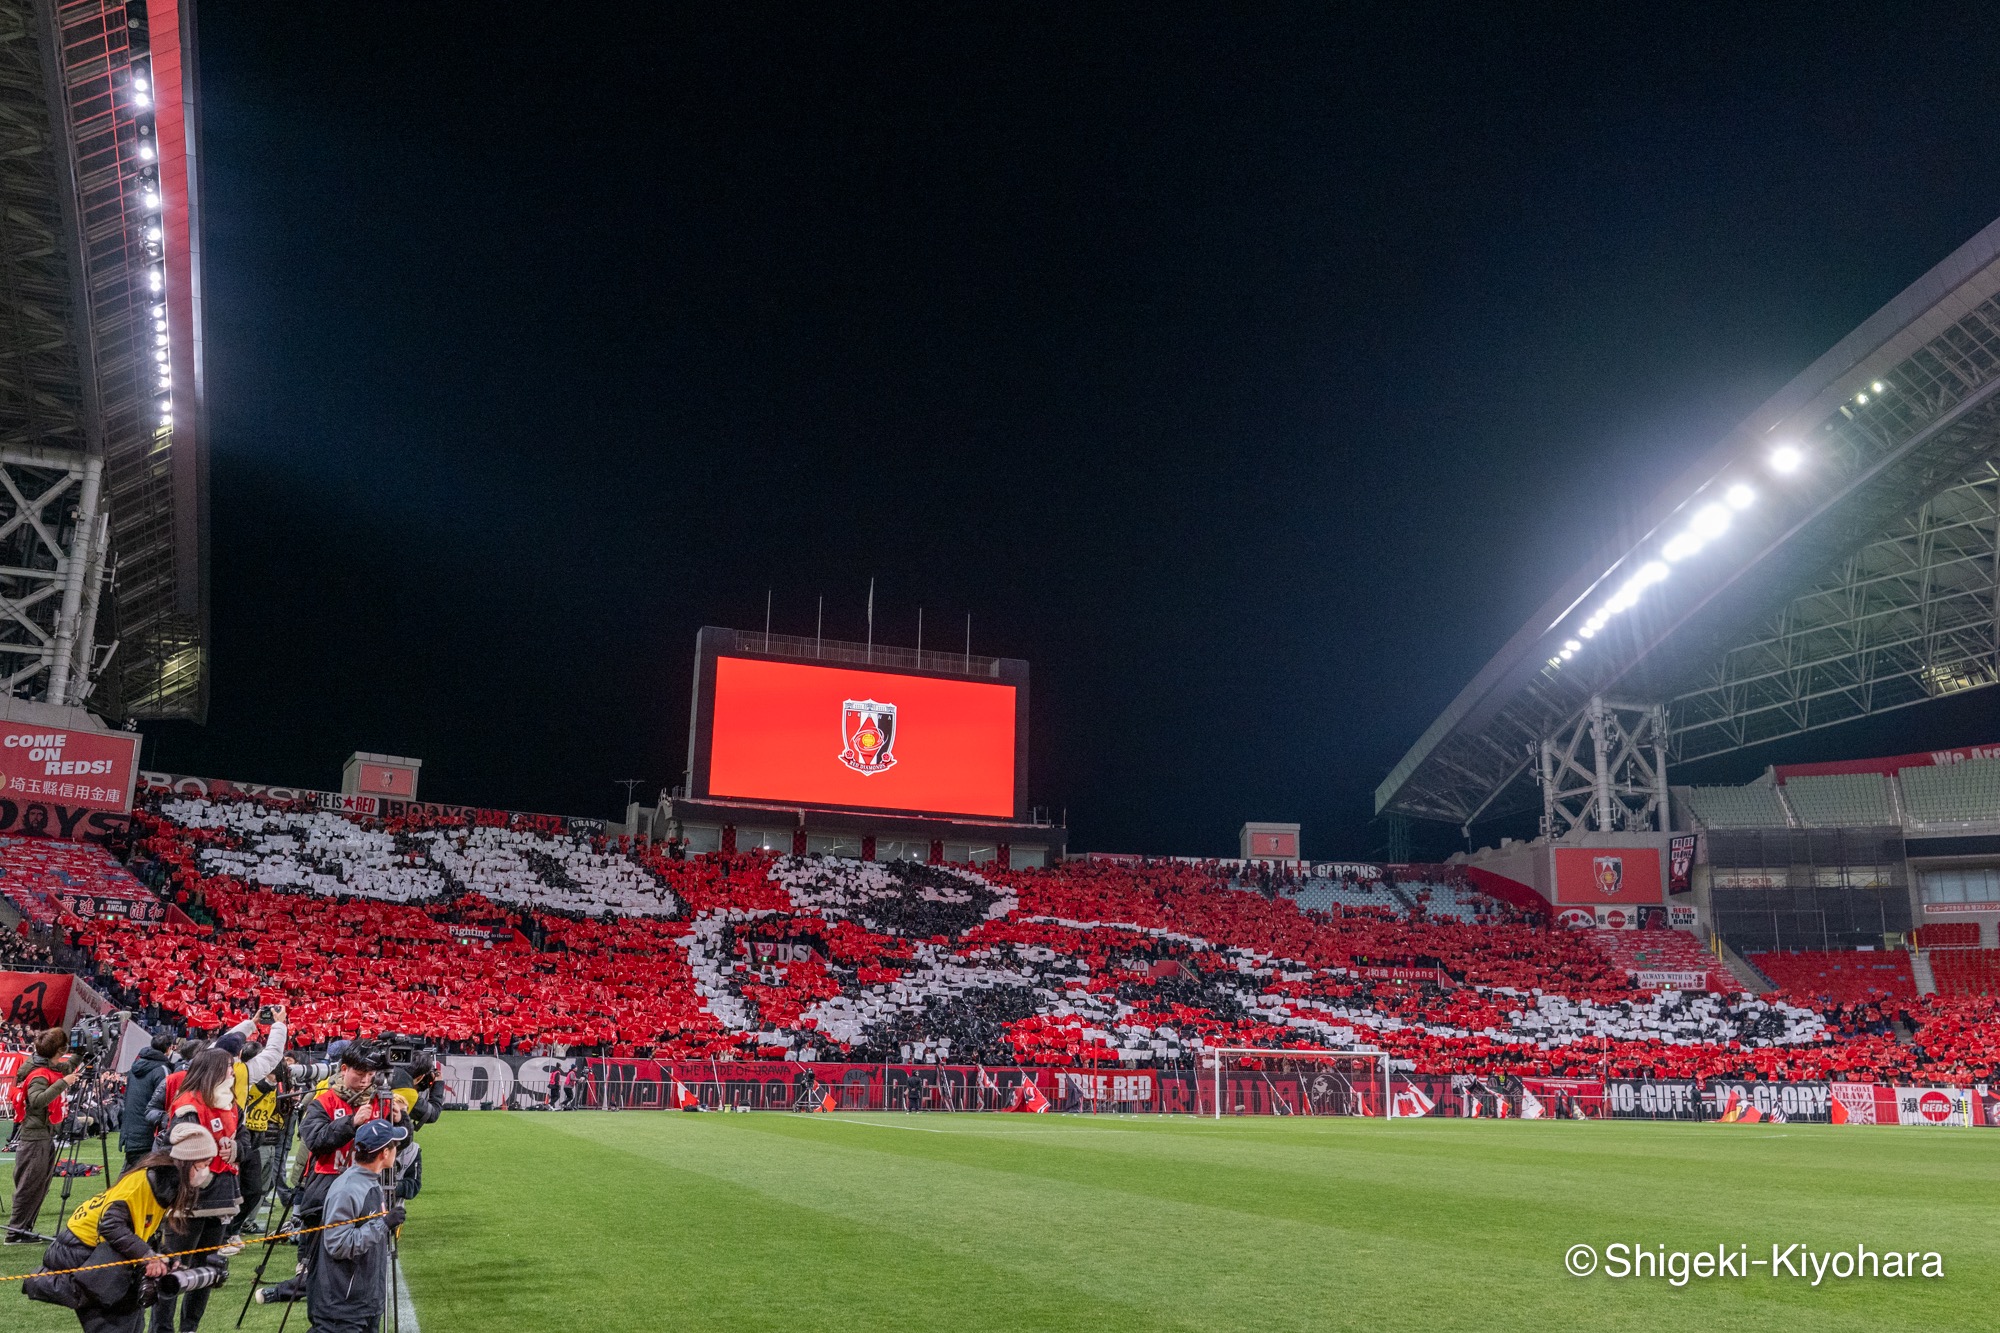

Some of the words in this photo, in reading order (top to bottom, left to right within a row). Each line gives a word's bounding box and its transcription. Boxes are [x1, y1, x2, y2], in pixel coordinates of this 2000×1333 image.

[4, 735, 67, 748] COME
[28, 748, 61, 762] ON
[45, 760, 113, 776] REDS!
[9, 776, 121, 803] 埼玉縣信用金庫
[355, 796, 376, 813] RED
[448, 925, 491, 939] Fighting
[678, 1065, 700, 1076] THE
[736, 1065, 751, 1076] OF
[754, 1065, 791, 1076] URAWA
[847, 1071, 866, 1080] RIP
[1113, 1075, 1152, 1101] RED
[1834, 1085, 1849, 1093] GET
[1851, 1085, 1872, 1093] GOAL
[1835, 1092, 1873, 1101] URAWA
[1921, 1103, 1950, 1113] REDS
